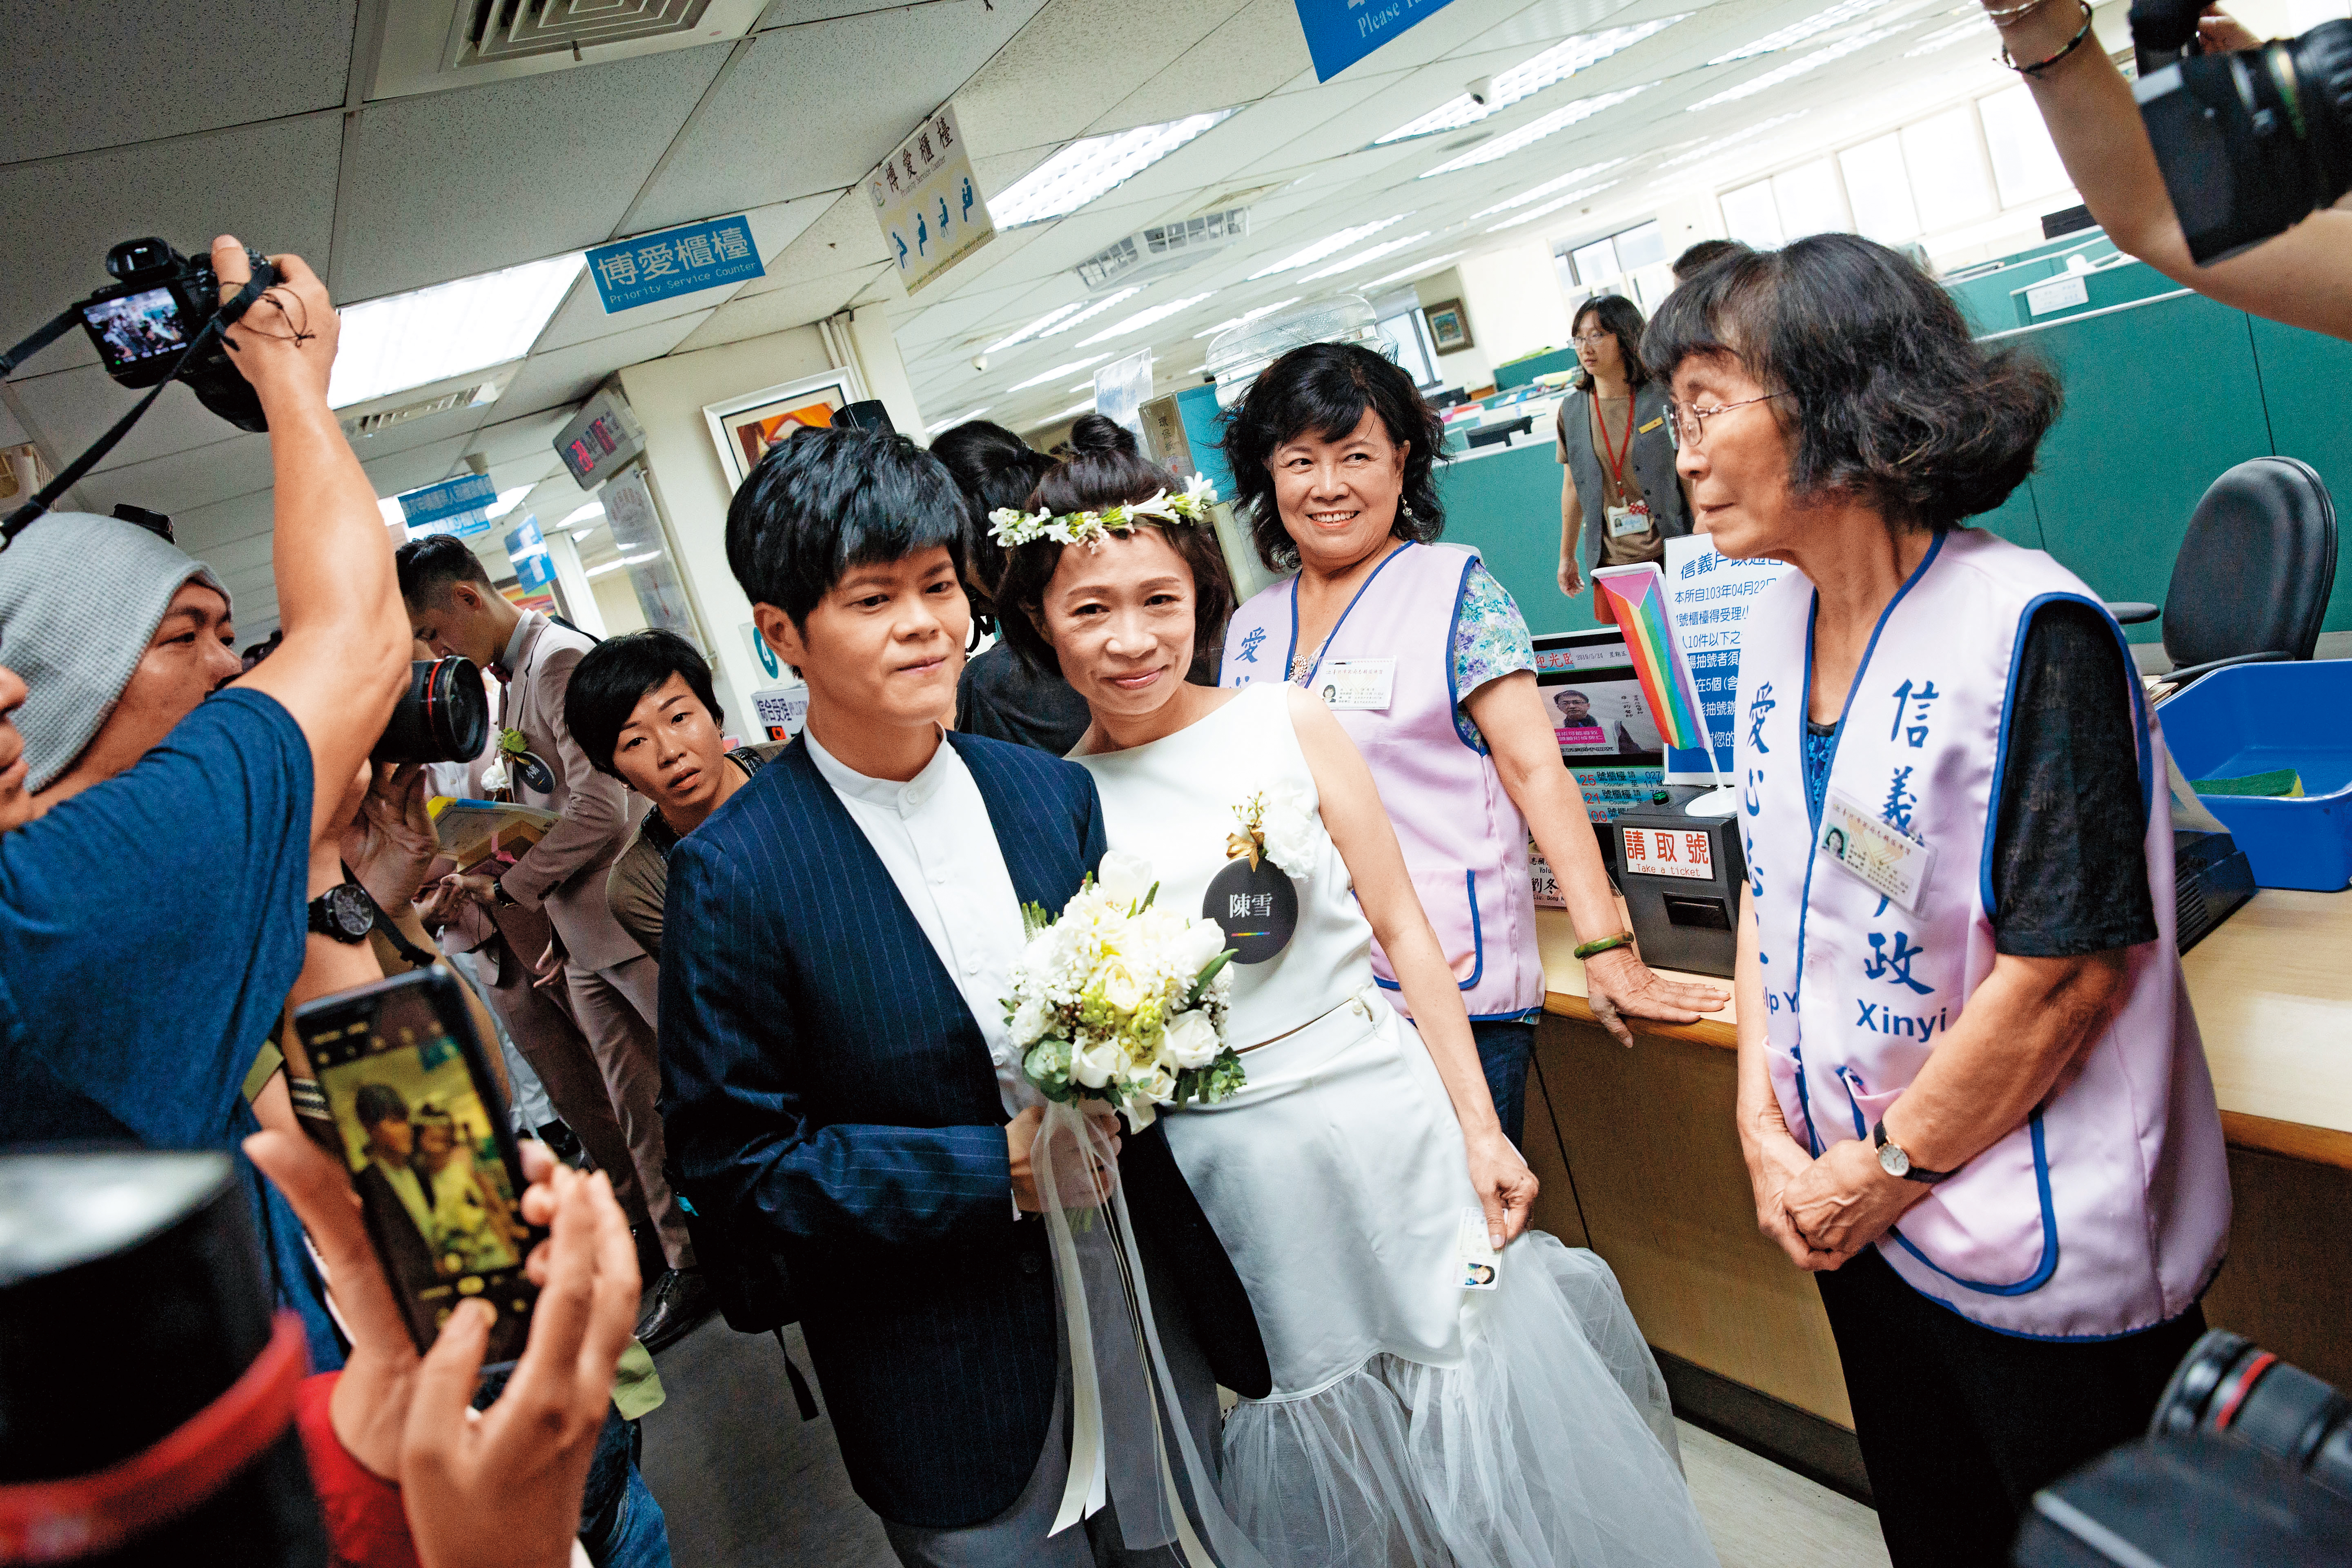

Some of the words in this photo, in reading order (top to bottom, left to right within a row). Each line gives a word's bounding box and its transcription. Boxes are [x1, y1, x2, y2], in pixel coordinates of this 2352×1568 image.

[1356, 2, 1400, 38] Please
[886, 117, 953, 193] 博愛櫃檯
[598, 227, 750, 290] 博愛櫃檯
[609, 284, 662, 304] Priority
[667, 272, 711, 289] Service
[715, 261, 756, 277] Counter
[760, 637, 773, 666] 4
[1576, 652, 1603, 661] 2019/5/24
[1695, 675, 1738, 692] 在5個(含
[1710, 731, 1734, 748] 您的
[1579, 774, 1596, 786] 25
[1645, 771, 1661, 779] 027
[1644, 780, 1653, 788] 11
[1585, 793, 1600, 804] 21
[1591, 811, 1607, 822] 00
[1625, 830, 1708, 864] 請取號
[1864, 678, 1939, 995] 信義政
[1637, 863, 1656, 873] Take
[1670, 866, 1700, 877] ticket
[1229, 893, 1273, 918] 陳雪
[1762, 987, 1779, 1015] lp
[1856, 998, 1947, 1043] Xinyi
